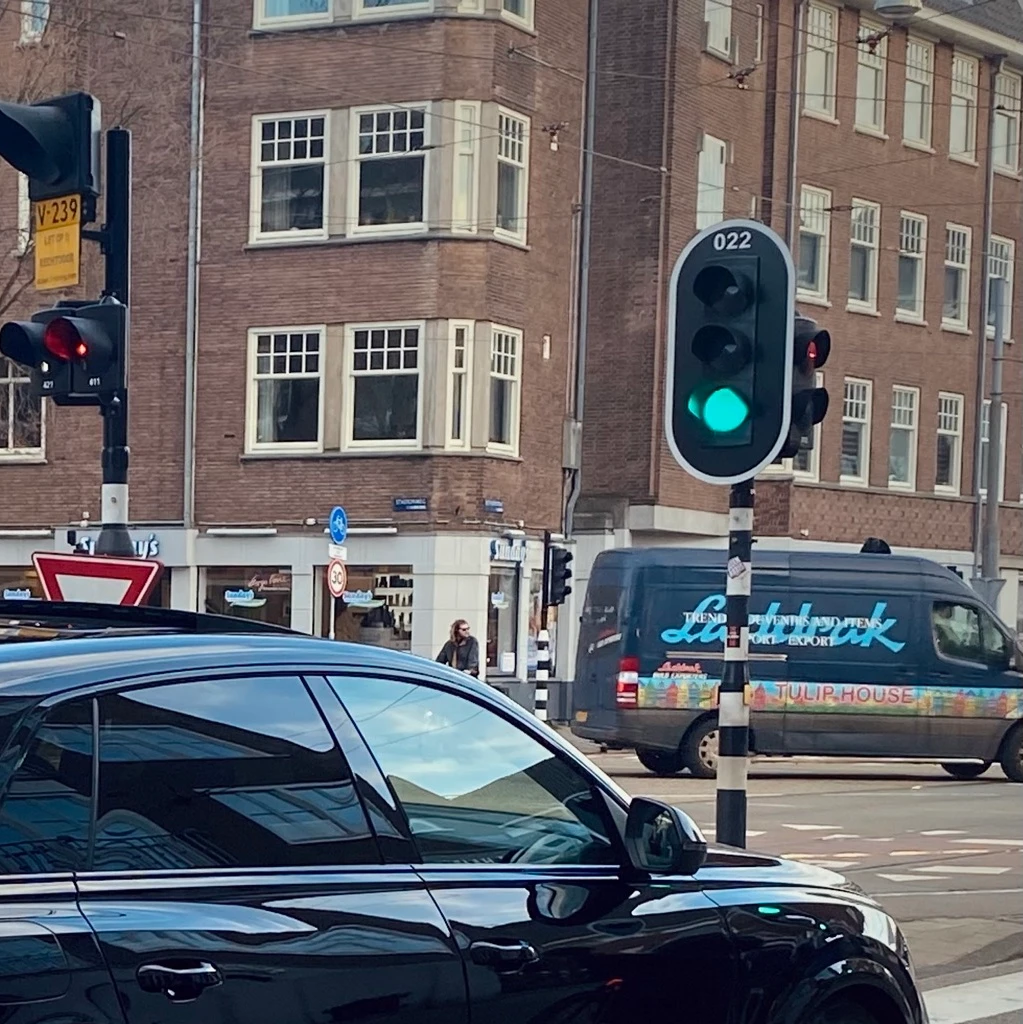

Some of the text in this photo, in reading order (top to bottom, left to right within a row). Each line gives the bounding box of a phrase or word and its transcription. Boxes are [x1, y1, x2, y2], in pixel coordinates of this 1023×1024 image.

[37, 198, 78, 226] V-239
[713, 231, 752, 251] 022
[331, 570, 343, 585] 30
[813, 615, 839, 627] AND
[787, 636, 835, 647] EXPORT
[775, 684, 914, 704] TULIP HOUSE
